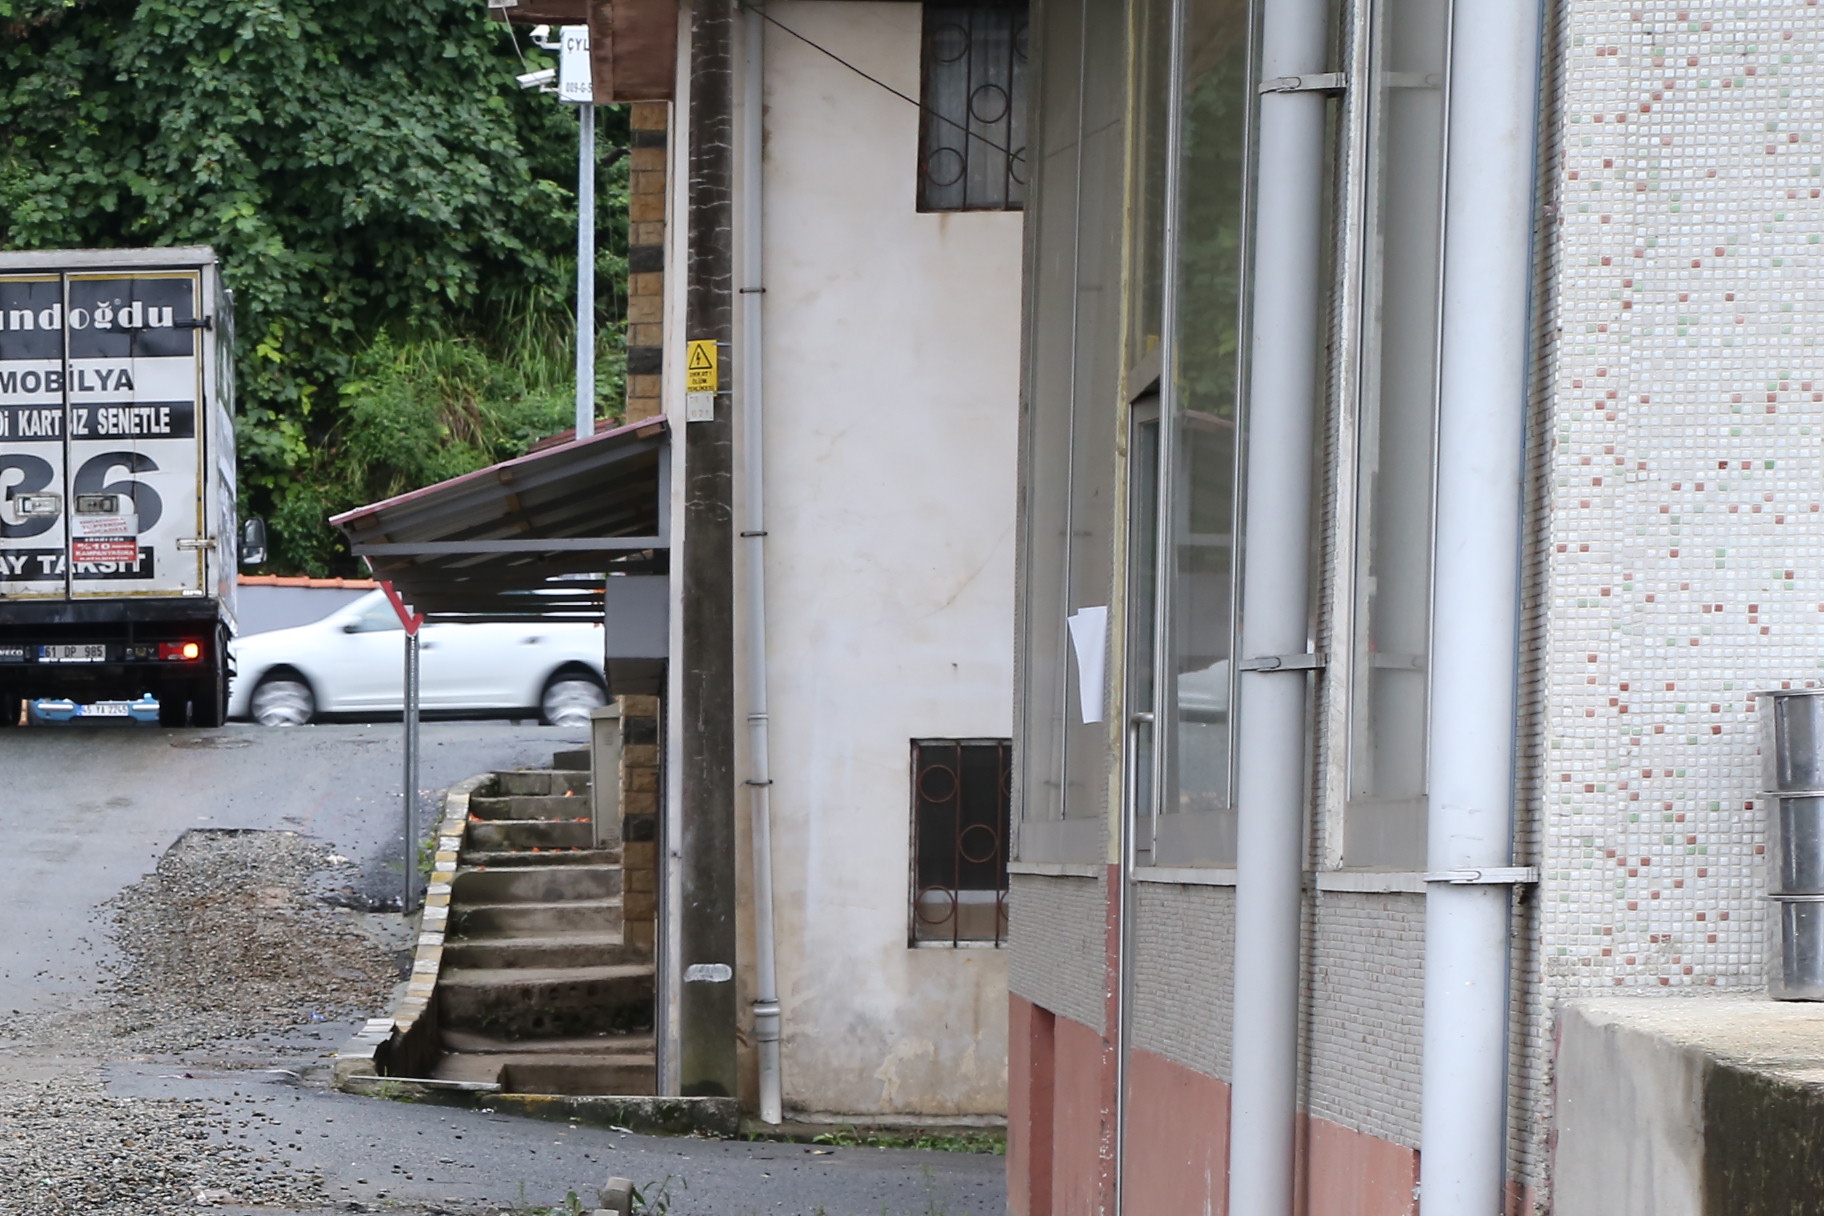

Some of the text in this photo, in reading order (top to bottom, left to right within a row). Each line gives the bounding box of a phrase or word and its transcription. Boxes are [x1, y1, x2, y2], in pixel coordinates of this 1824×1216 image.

[18, 409, 89, 437] KARTIZ
[98, 407, 171, 435] SENETLE
[44, 646, 56, 657] 61
[84, 645, 103, 657] 985
